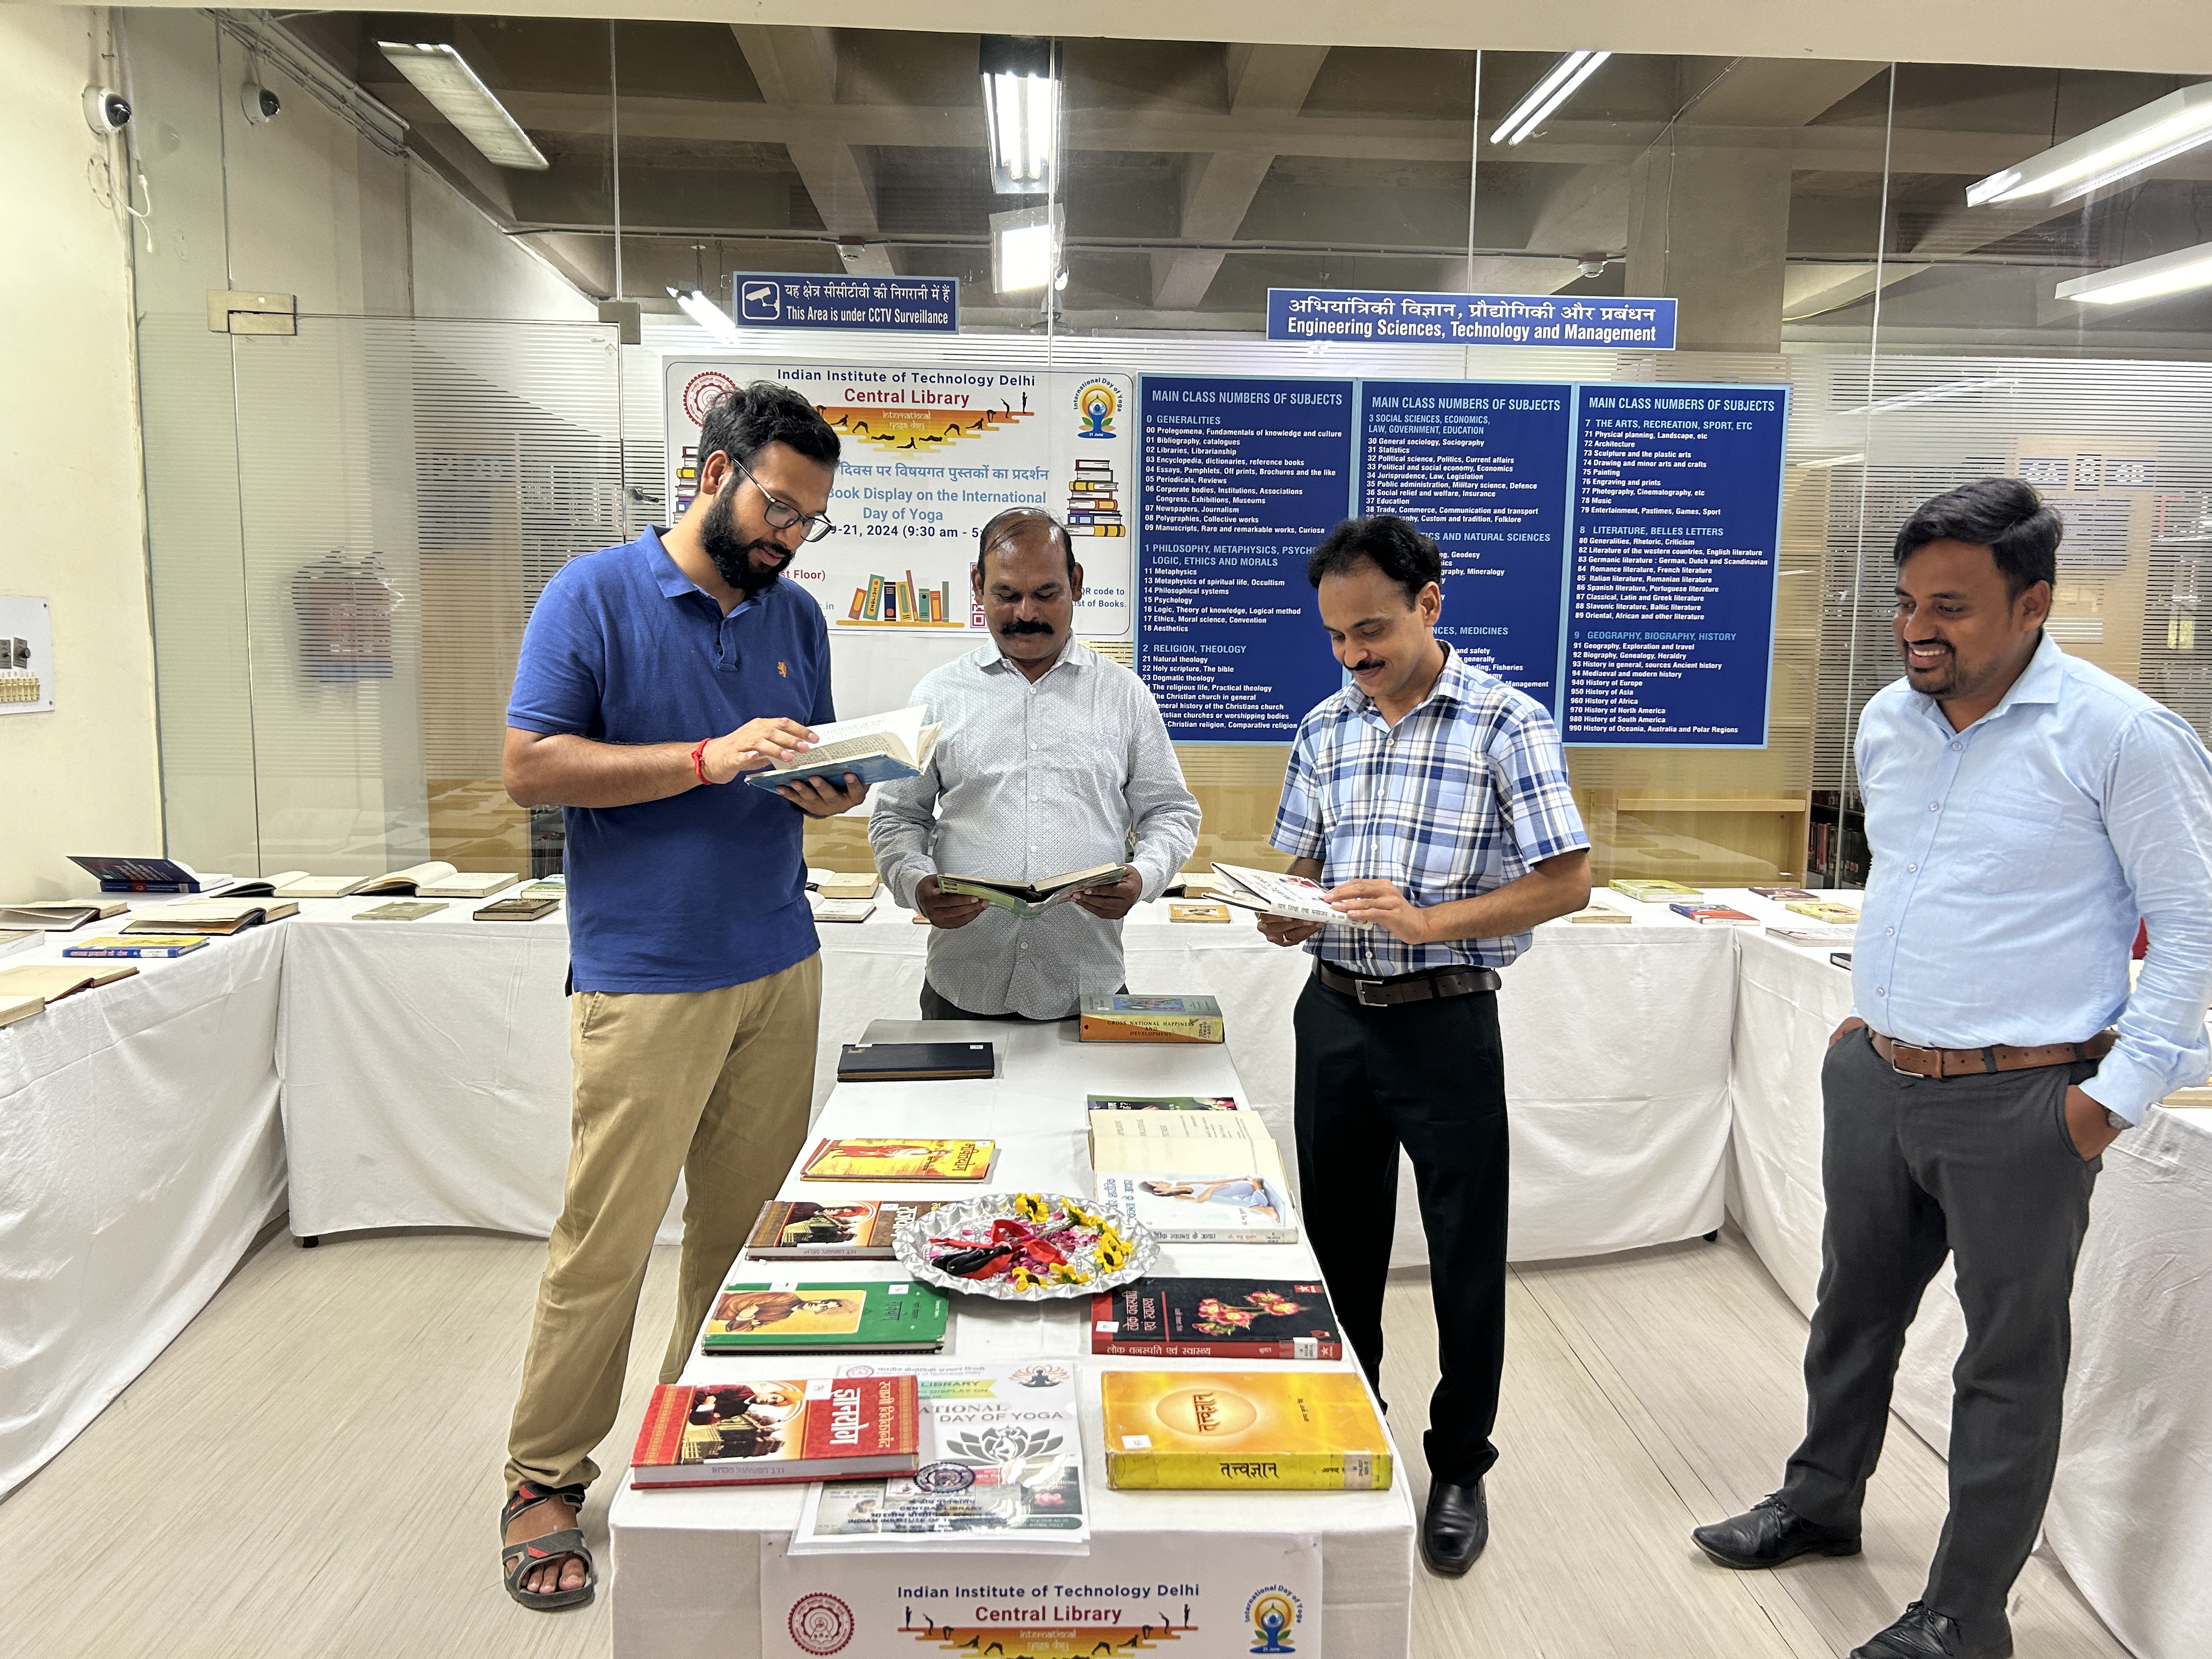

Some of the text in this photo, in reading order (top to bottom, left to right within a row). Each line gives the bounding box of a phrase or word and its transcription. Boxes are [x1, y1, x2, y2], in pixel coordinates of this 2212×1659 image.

[784, 284, 800, 300] यह
[803, 280, 821, 300] क्षेत्र
[823, 281, 871, 298] सीसीटीवी
[872, 283, 888, 300] की
[890, 283, 929, 301] निगरानी
[930, 284, 940, 301] में
[786, 305, 948, 325] This Area is under CCTV Surveillance
[1289, 295, 1656, 322] अभियांत्रिकी विज्ञान, प्रौद्योगिकी और प्रबंधन
[1288, 317, 1656, 344] Engineering Sciences, Technology and Management
[778, 368, 1035, 387] Indian Institute of Technology Delhi
[844, 387, 969, 409] Central Library
[1074, 377, 1101, 410] International
[1102, 378, 1114, 388] Day
[1152, 390, 1342, 406] MAIN CLASS NUMBERS OF SUBJECTS
[1372, 396, 1560, 411] MAIN CLASS NUMBERS OF SUBJECTS
[1589, 397, 1774, 411] MAIN CLASS NUMBERS OF SUBJECTS
[1147, 415, 1221, 425] 0 GENERALITIES
[1369, 414, 1490, 425] 3 SOCIAL SCIENCES, ECONOMICS,
[1585, 419, 1752, 431] 7 THE ARTS, RECREATION, SPORT, ETC
[1368, 424, 1484, 435] LAW, GOVERNMENT, EDUCATION
[1146, 445, 1237, 456] 02 Libraries, Librarianship
[1378, 445, 1410, 454] Statistics
[1594, 439, 1635, 448] Architecture
[839, 461, 1049, 482] दिवस पर विषयगत पुस्तकों का प्रदर्शन
[864, 487, 913, 504] Display
[916, 491, 933, 501] on
[936, 488, 958, 502] the
[962, 489, 1046, 504] International
[863, 507, 943, 524] Day of Yoga
[831, 523, 862, 538] 9-21,
[867, 524, 899, 536] 2024
[903, 524, 935, 539] (9:30
[939, 528, 958, 538] am
[1442, 532, 1550, 542] AND NATURAL SCIENCES
[1579, 526, 1724, 537] 8 LITERATURE, BELLES LETTERS
[1153, 556, 1278, 567] LOGIC, ETHICS AND MORALS
[794, 569, 826, 582] Floor)
[1093, 587, 1114, 595] code
[1154, 586, 1199, 595] Philosophical
[1201, 588, 1229, 596] systems
[1098, 600, 1127, 608] Books.
[1574, 631, 1737, 641] 9 GEOGRAPHY, BIOGRAPHY, HISTORY
[1143, 644, 1246, 654] 2 RELIGION, THEOLOGY
[1107, 1344, 1125, 1354] लोक
[1129, 1345, 1163, 1355] वनस्पति
[1166, 1345, 1178, 1355] एवं
[1182, 1346, 1211, 1355] स्वास्थ्य
[830, 1387, 870, 1444] ज्ञानयोग
[878, 1381, 895, 1448] स्वामी विवेकानंद
[919, 1404, 1008, 1414] ATIONAL
[940, 1414, 976, 1423] DAY
[981, 1413, 1006, 1421] OF
[1219, 1462, 1280, 1479] तत्त्वज्ञान
[898, 1583, 1199, 1599] Indian Institute of Technology Delhi
[1244, 1584, 1277, 1622] International
[1278, 1584, 1293, 1596] Day
[975, 1605, 1122, 1625] Central Library
